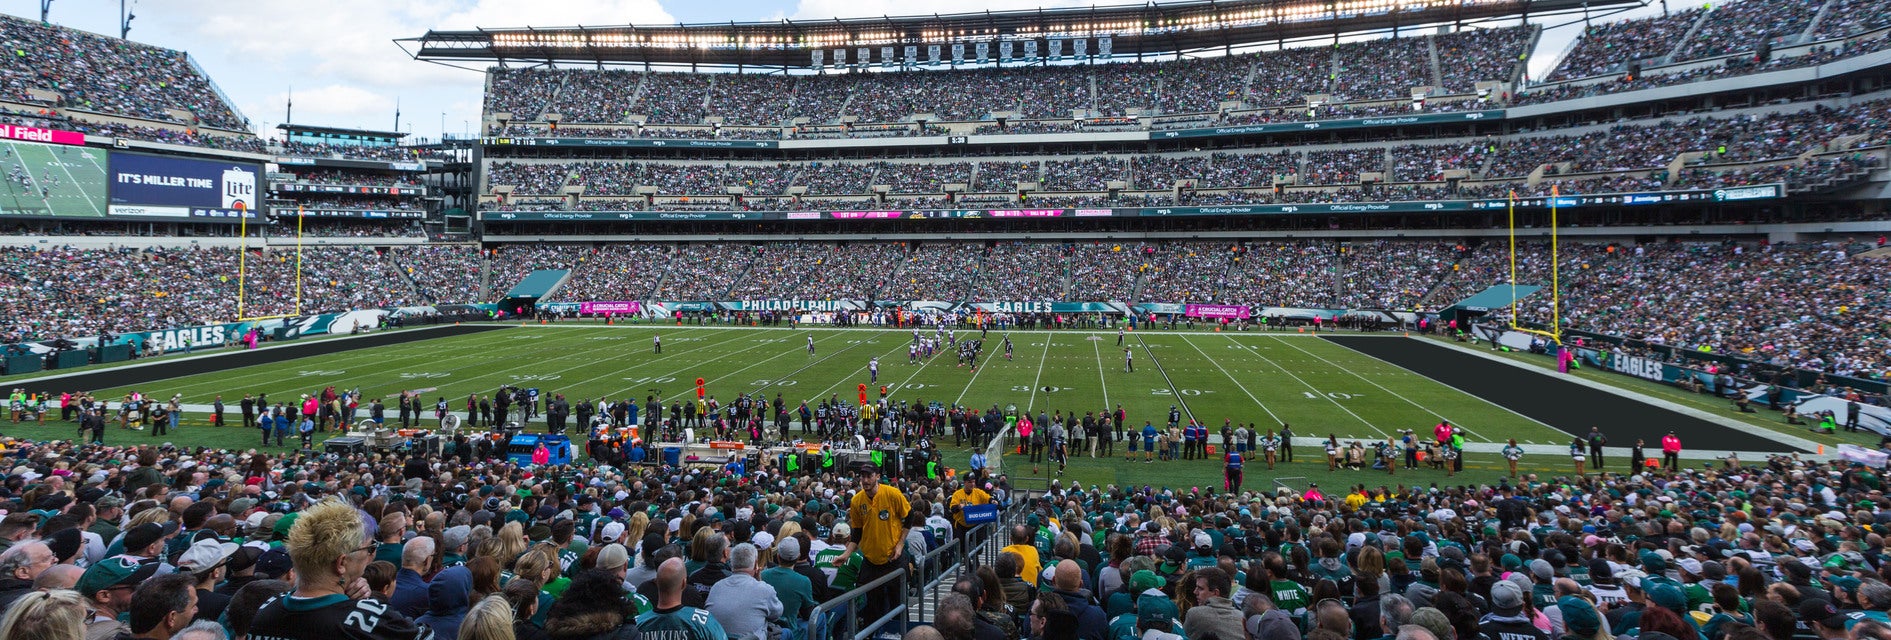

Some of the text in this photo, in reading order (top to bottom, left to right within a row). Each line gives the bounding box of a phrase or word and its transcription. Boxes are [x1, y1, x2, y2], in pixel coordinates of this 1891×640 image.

[14, 127, 53, 142] Field
[118, 173, 213, 189] IT'S MILLER TIME
[226, 180, 253, 198] Lite
[742, 300, 841, 311] PHILADELPHIA
[993, 301, 1053, 313] EAGLES
[151, 325, 225, 351] EAGLES
[1613, 353, 1663, 381] EAGLES
[920, 440, 930, 449] 91
[1276, 589, 1299, 601] WHITE
[691, 608, 709, 625] 20
